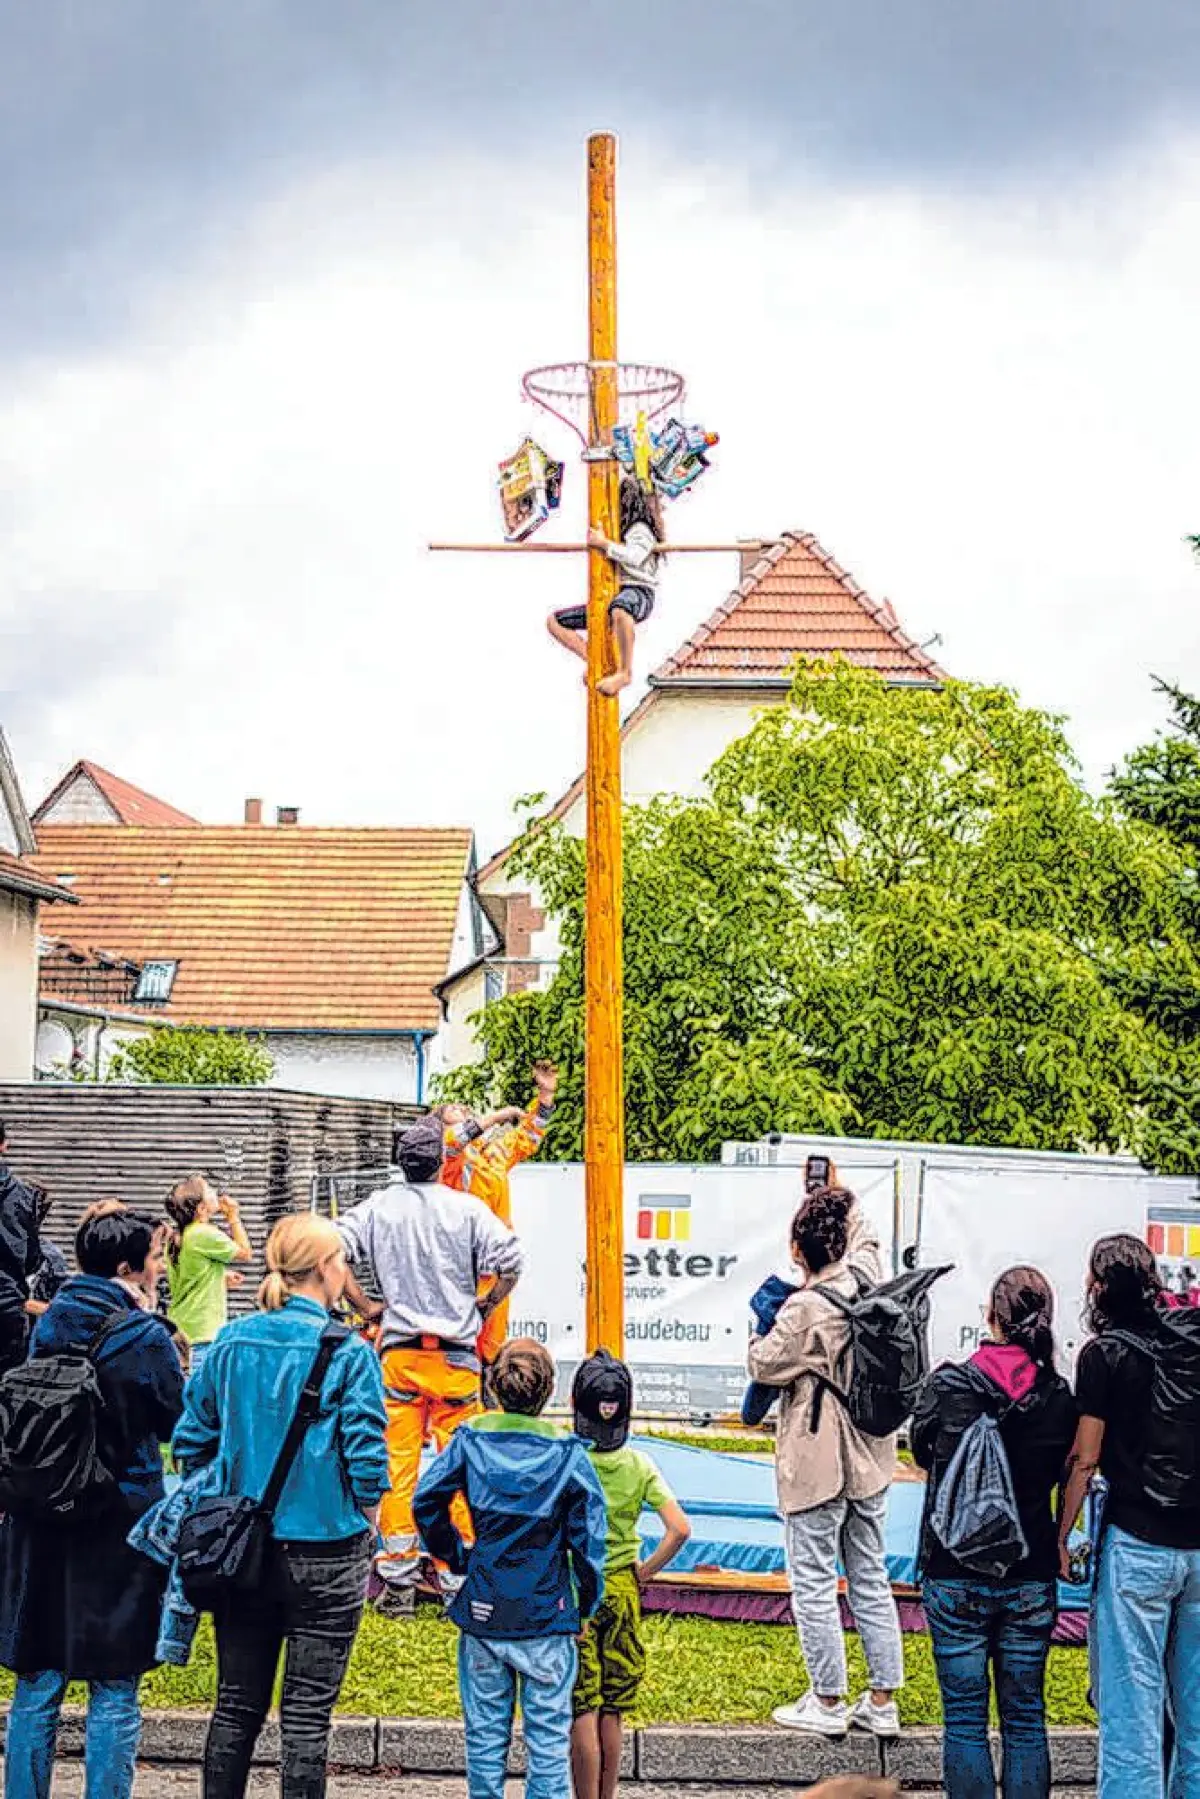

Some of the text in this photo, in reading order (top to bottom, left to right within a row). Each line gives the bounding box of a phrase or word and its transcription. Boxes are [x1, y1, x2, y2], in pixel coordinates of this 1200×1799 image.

[623, 1247, 739, 1278] etter
[624, 1286, 667, 1300] gruppe
[511, 1316, 711, 1343] ung äudebau
